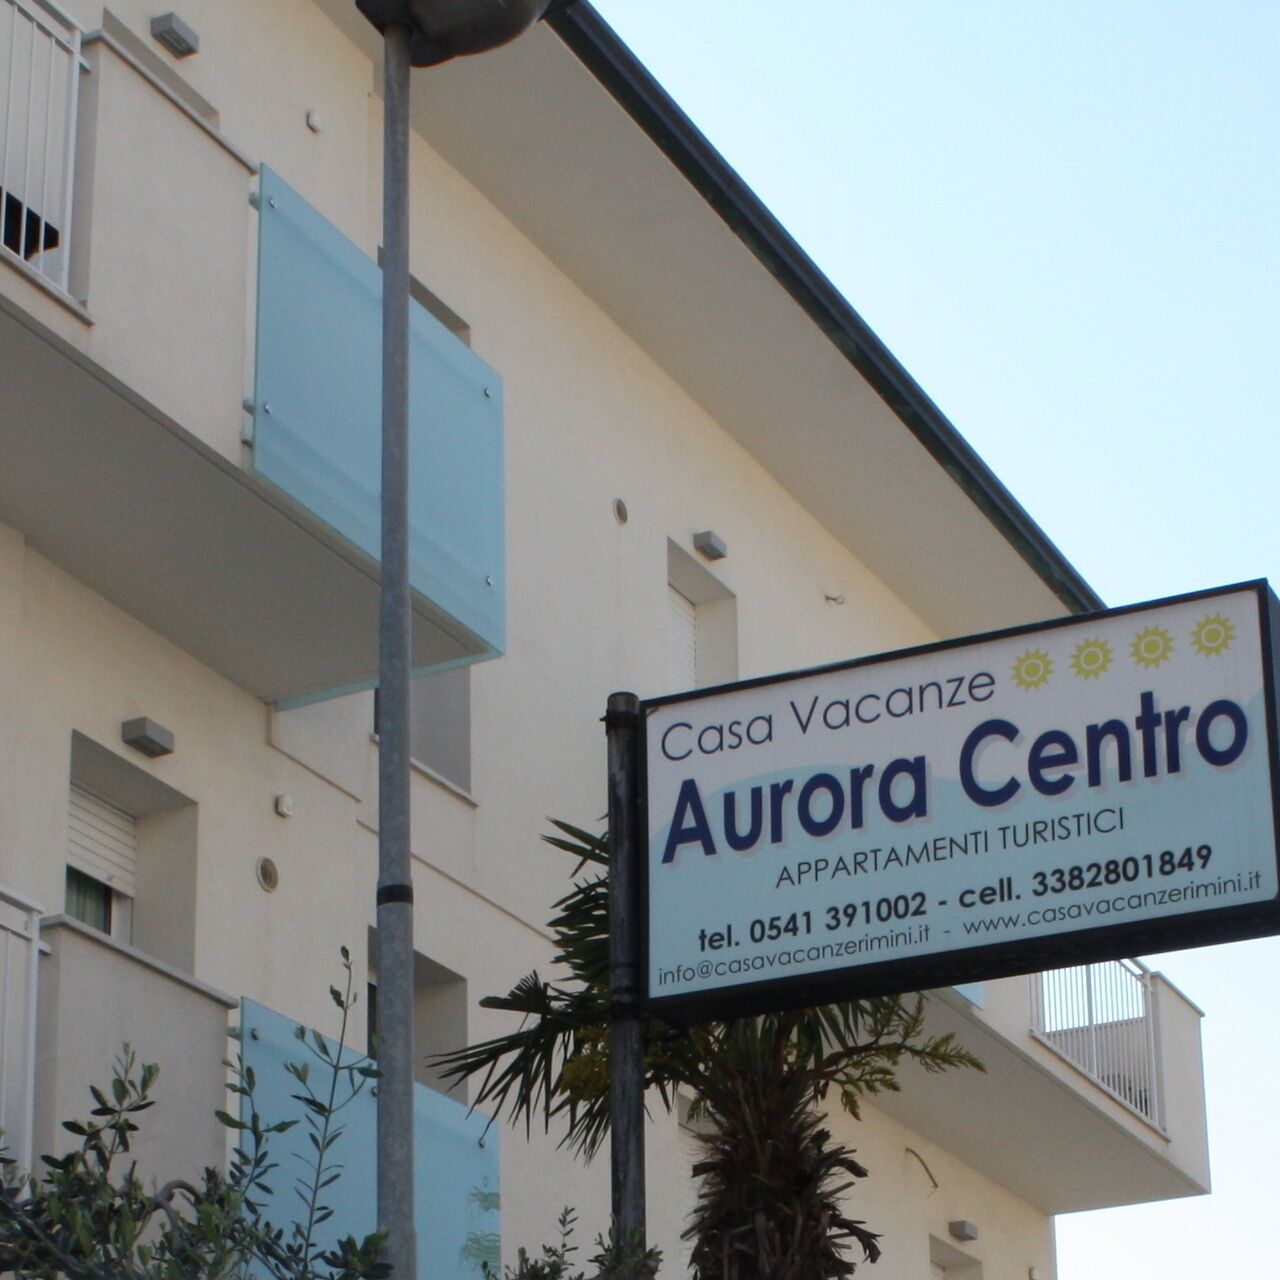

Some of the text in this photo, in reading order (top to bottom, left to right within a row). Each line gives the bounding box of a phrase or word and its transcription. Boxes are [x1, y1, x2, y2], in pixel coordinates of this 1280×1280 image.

[661, 672, 995, 761] Casa Vacanze
[661, 690, 1249, 864] Aurora Centro
[698, 924, 740, 952] tel.
[749, 911, 813, 944] 0541
[825, 891, 928, 931] 391002
[958, 876, 1021, 908] cell.
[1032, 844, 1213, 897] 3382801849
[775, 806, 1125, 889] APPARTAMENTI TURISTICI
[658, 924, 931, 986] info@casavacanzerimini.it
[963, 870, 1262, 934] www.casavacanzerimini.it
